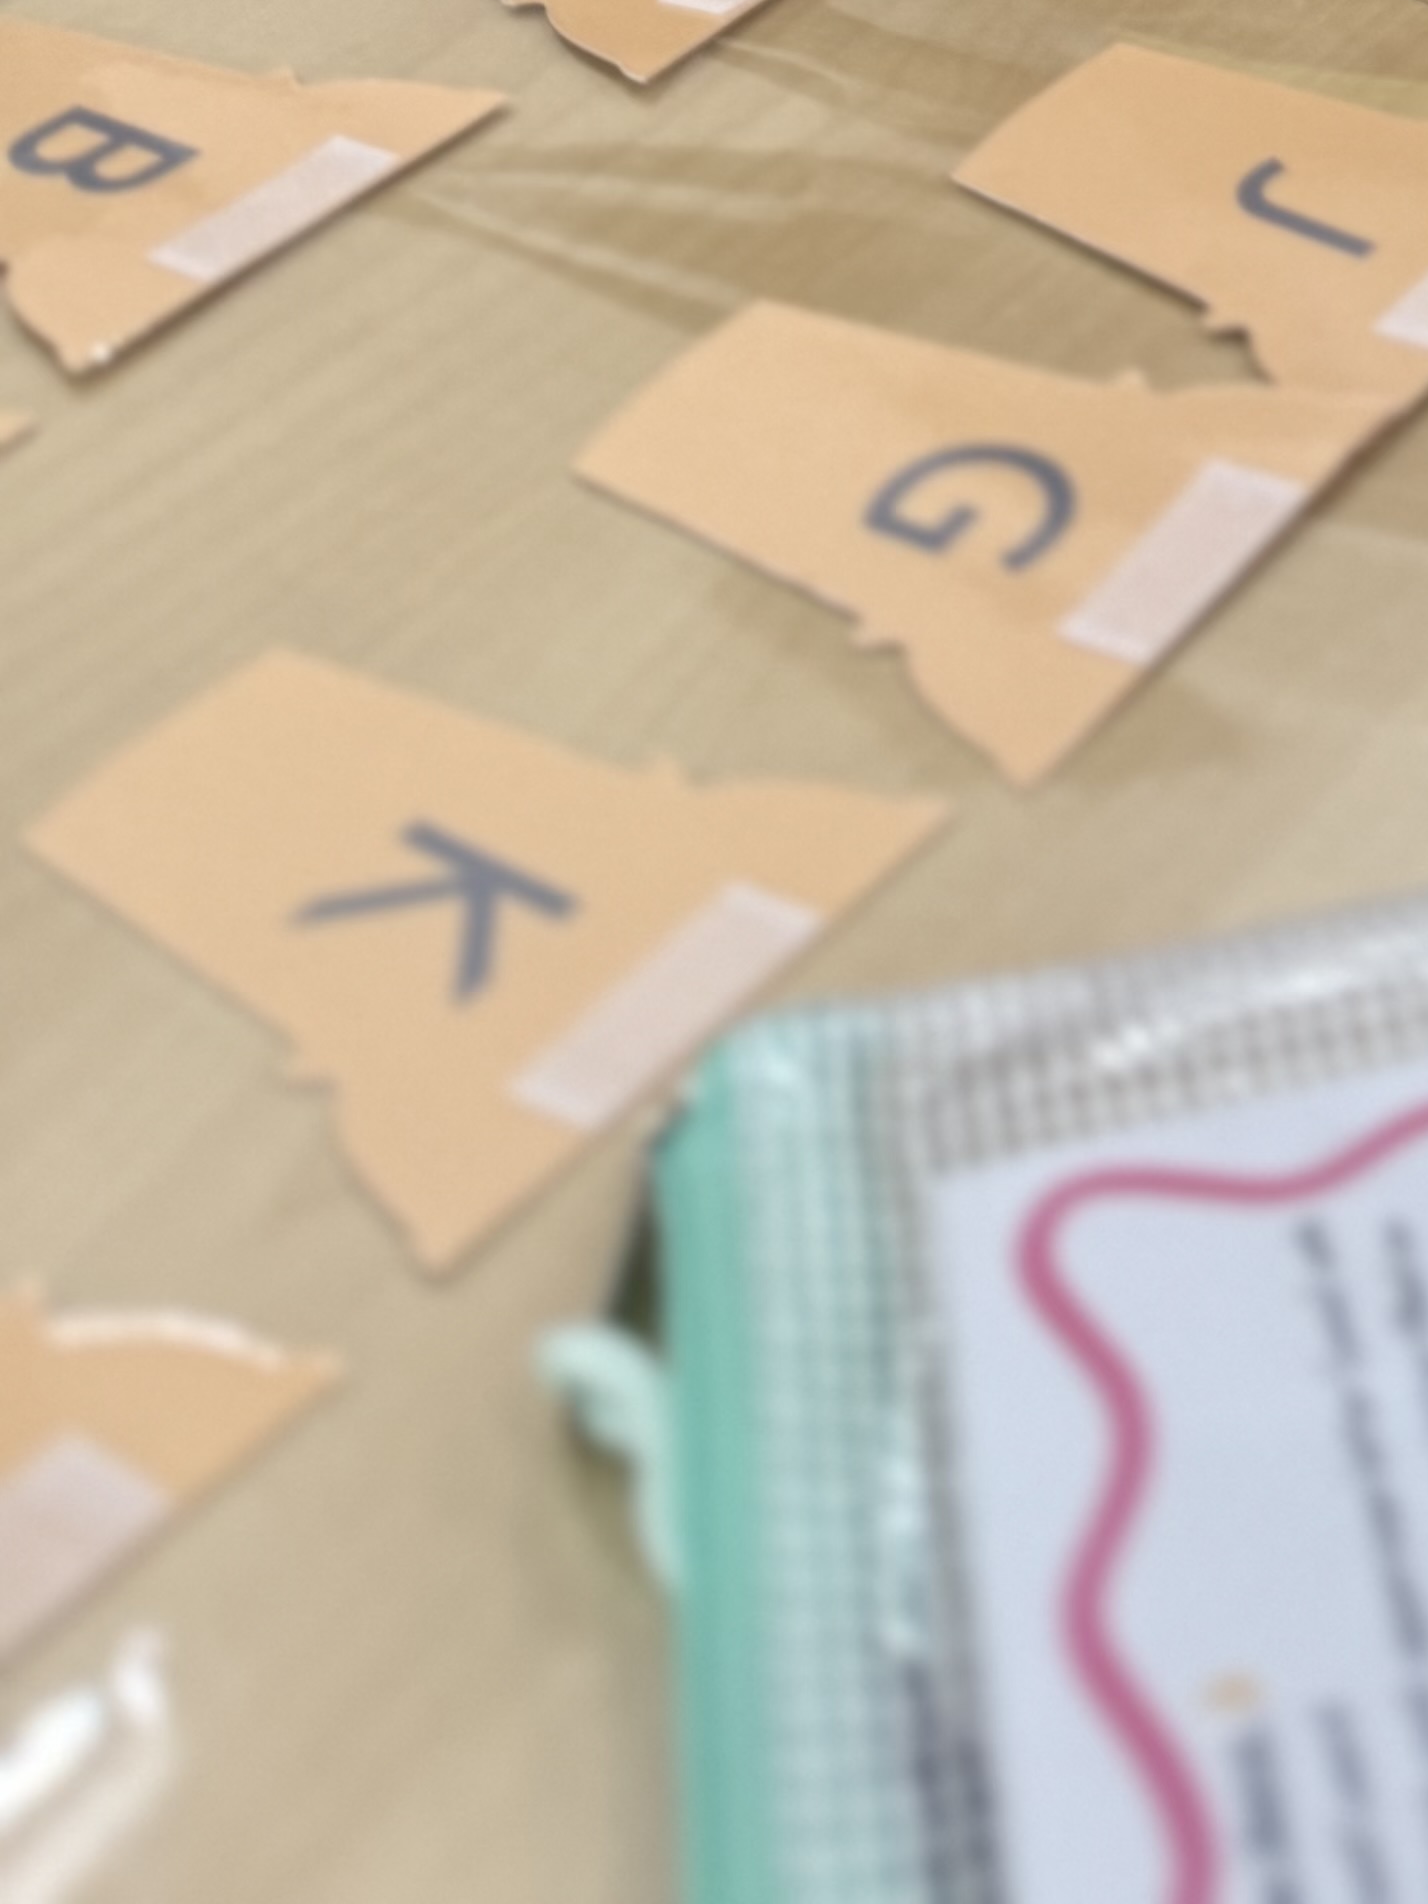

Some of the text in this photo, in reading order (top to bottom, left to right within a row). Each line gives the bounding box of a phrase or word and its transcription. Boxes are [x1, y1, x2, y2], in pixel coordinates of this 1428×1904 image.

[7, 105, 200, 192] B
[1236, 158, 1375, 260] J
[861, 441, 1077, 573] G
[289, 820, 581, 1003] K
